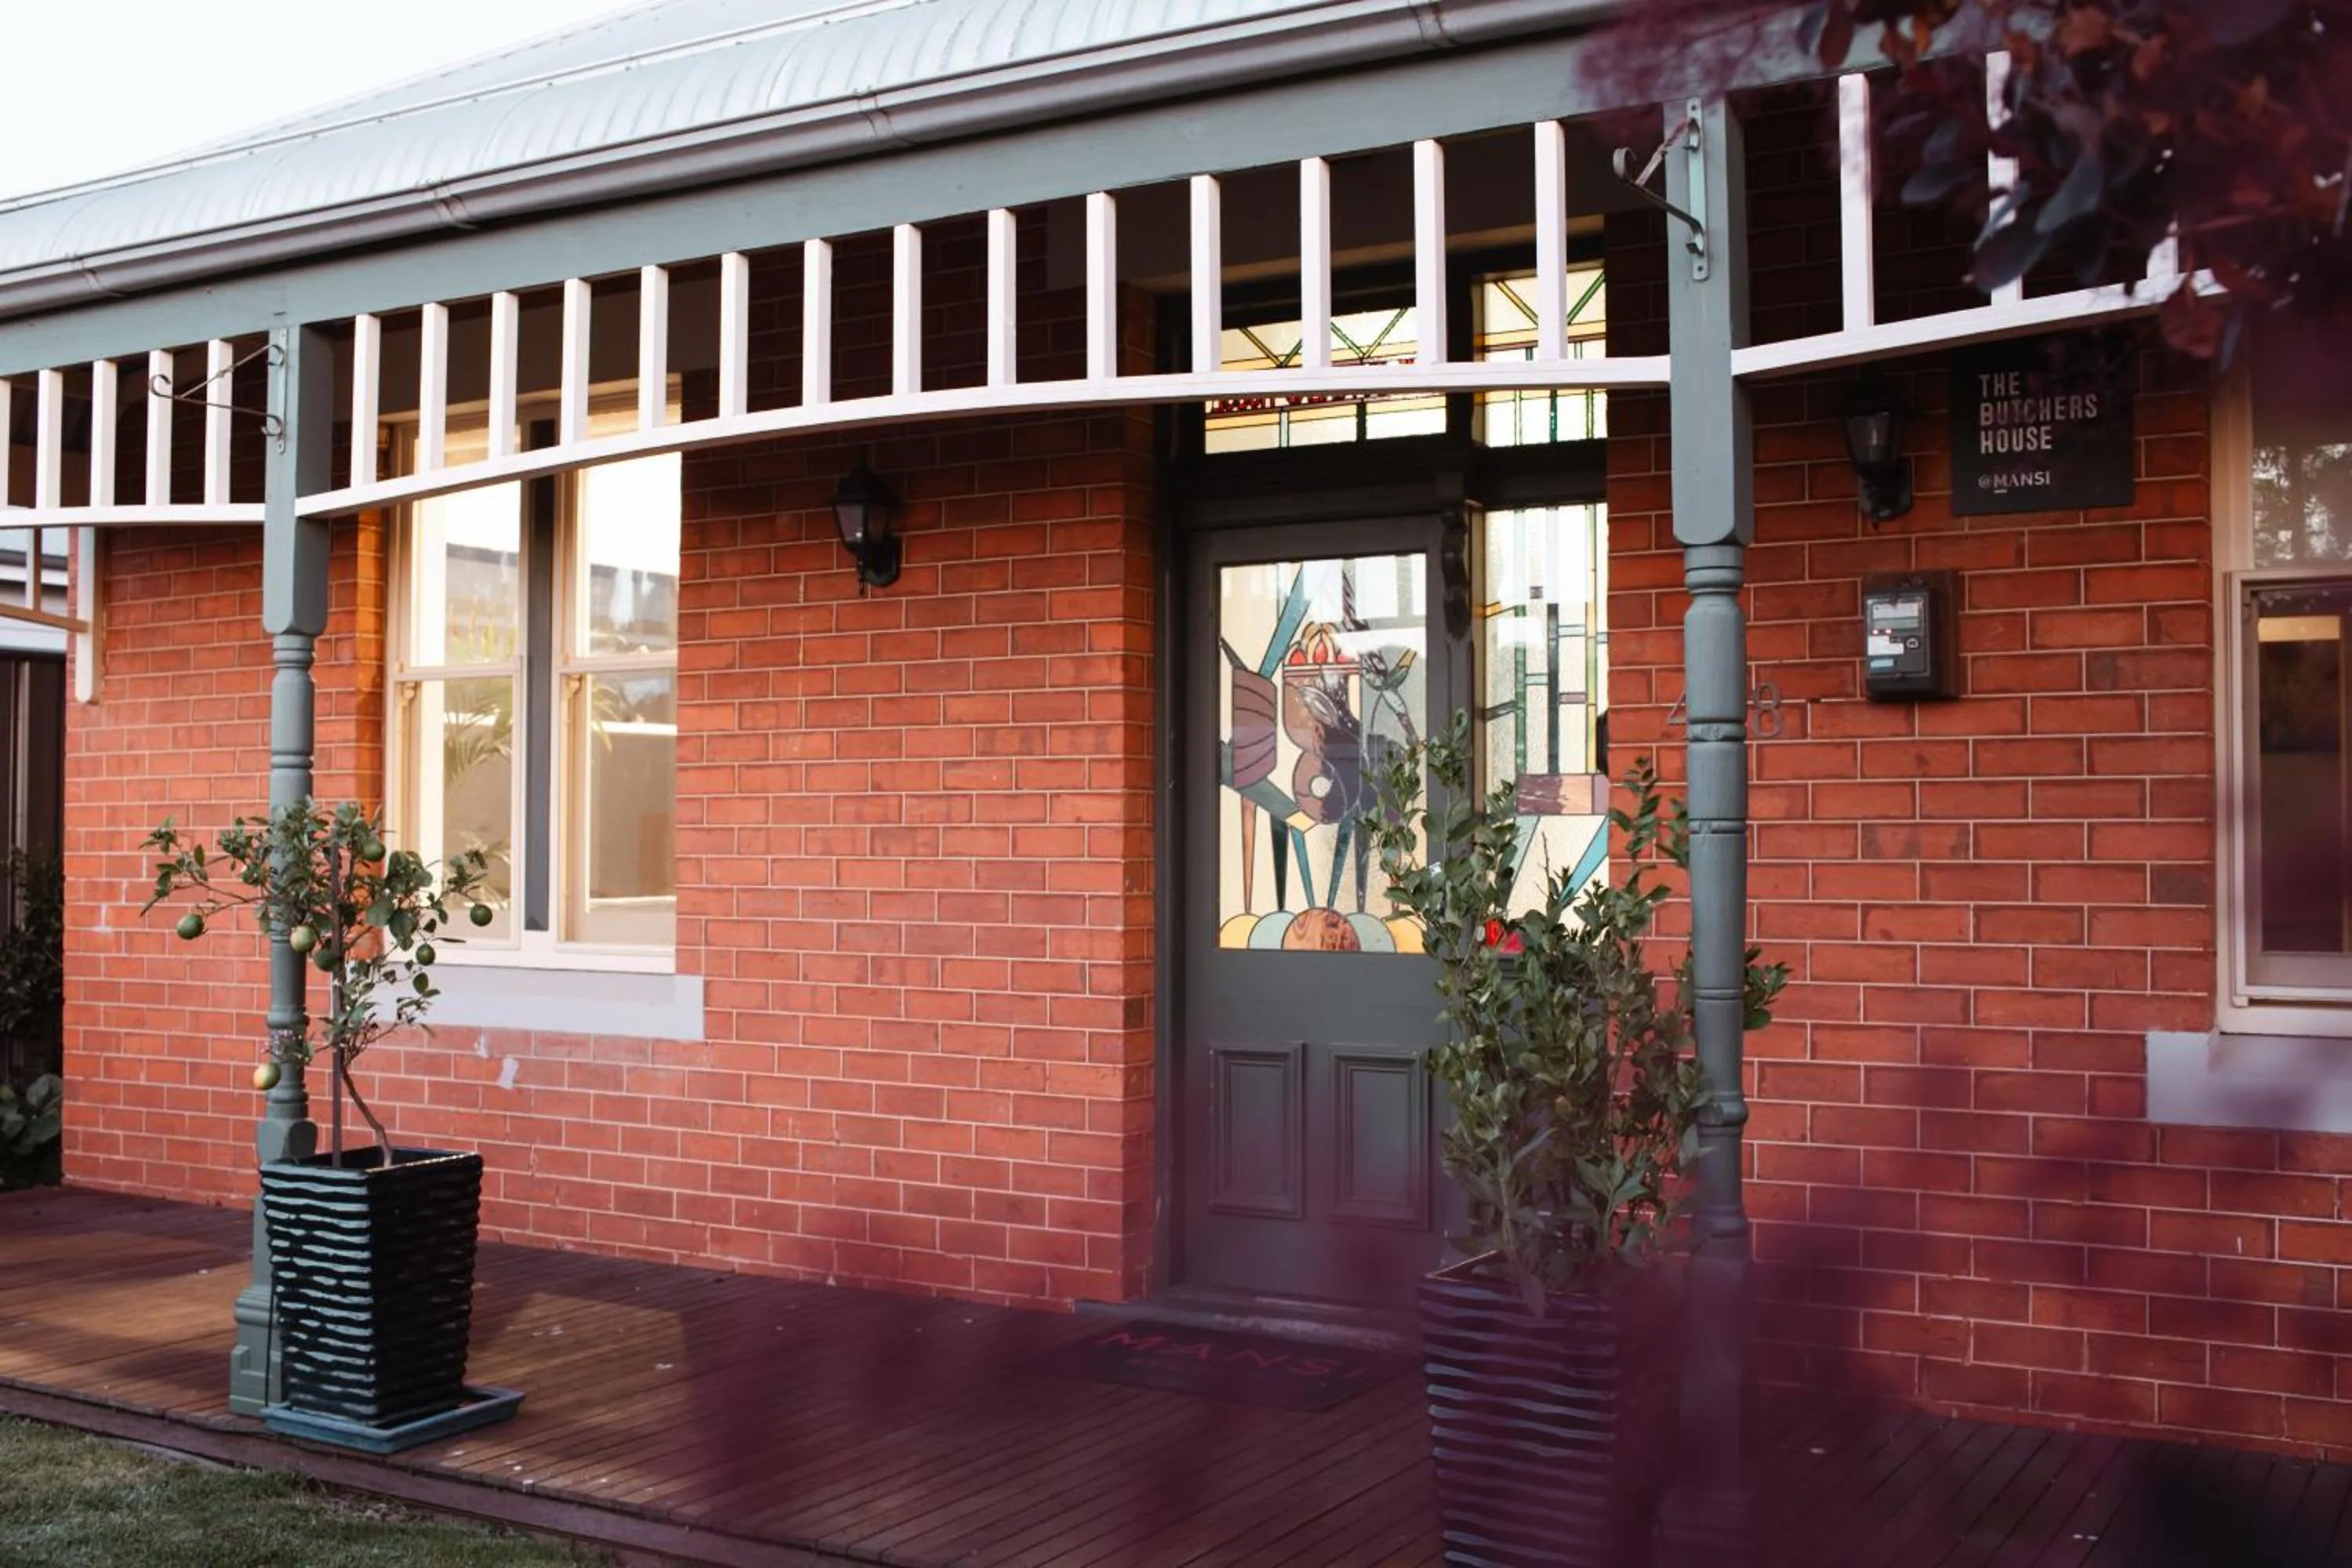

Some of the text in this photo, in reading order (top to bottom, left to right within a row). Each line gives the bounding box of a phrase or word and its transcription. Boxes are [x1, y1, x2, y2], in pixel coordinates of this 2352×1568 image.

[1978, 372, 2020, 397] THE
[1980, 394, 2099, 426] BUTCHERS
[1980, 426, 2053, 454] HOUSE
[1977, 470, 2052, 489] @MANSI
